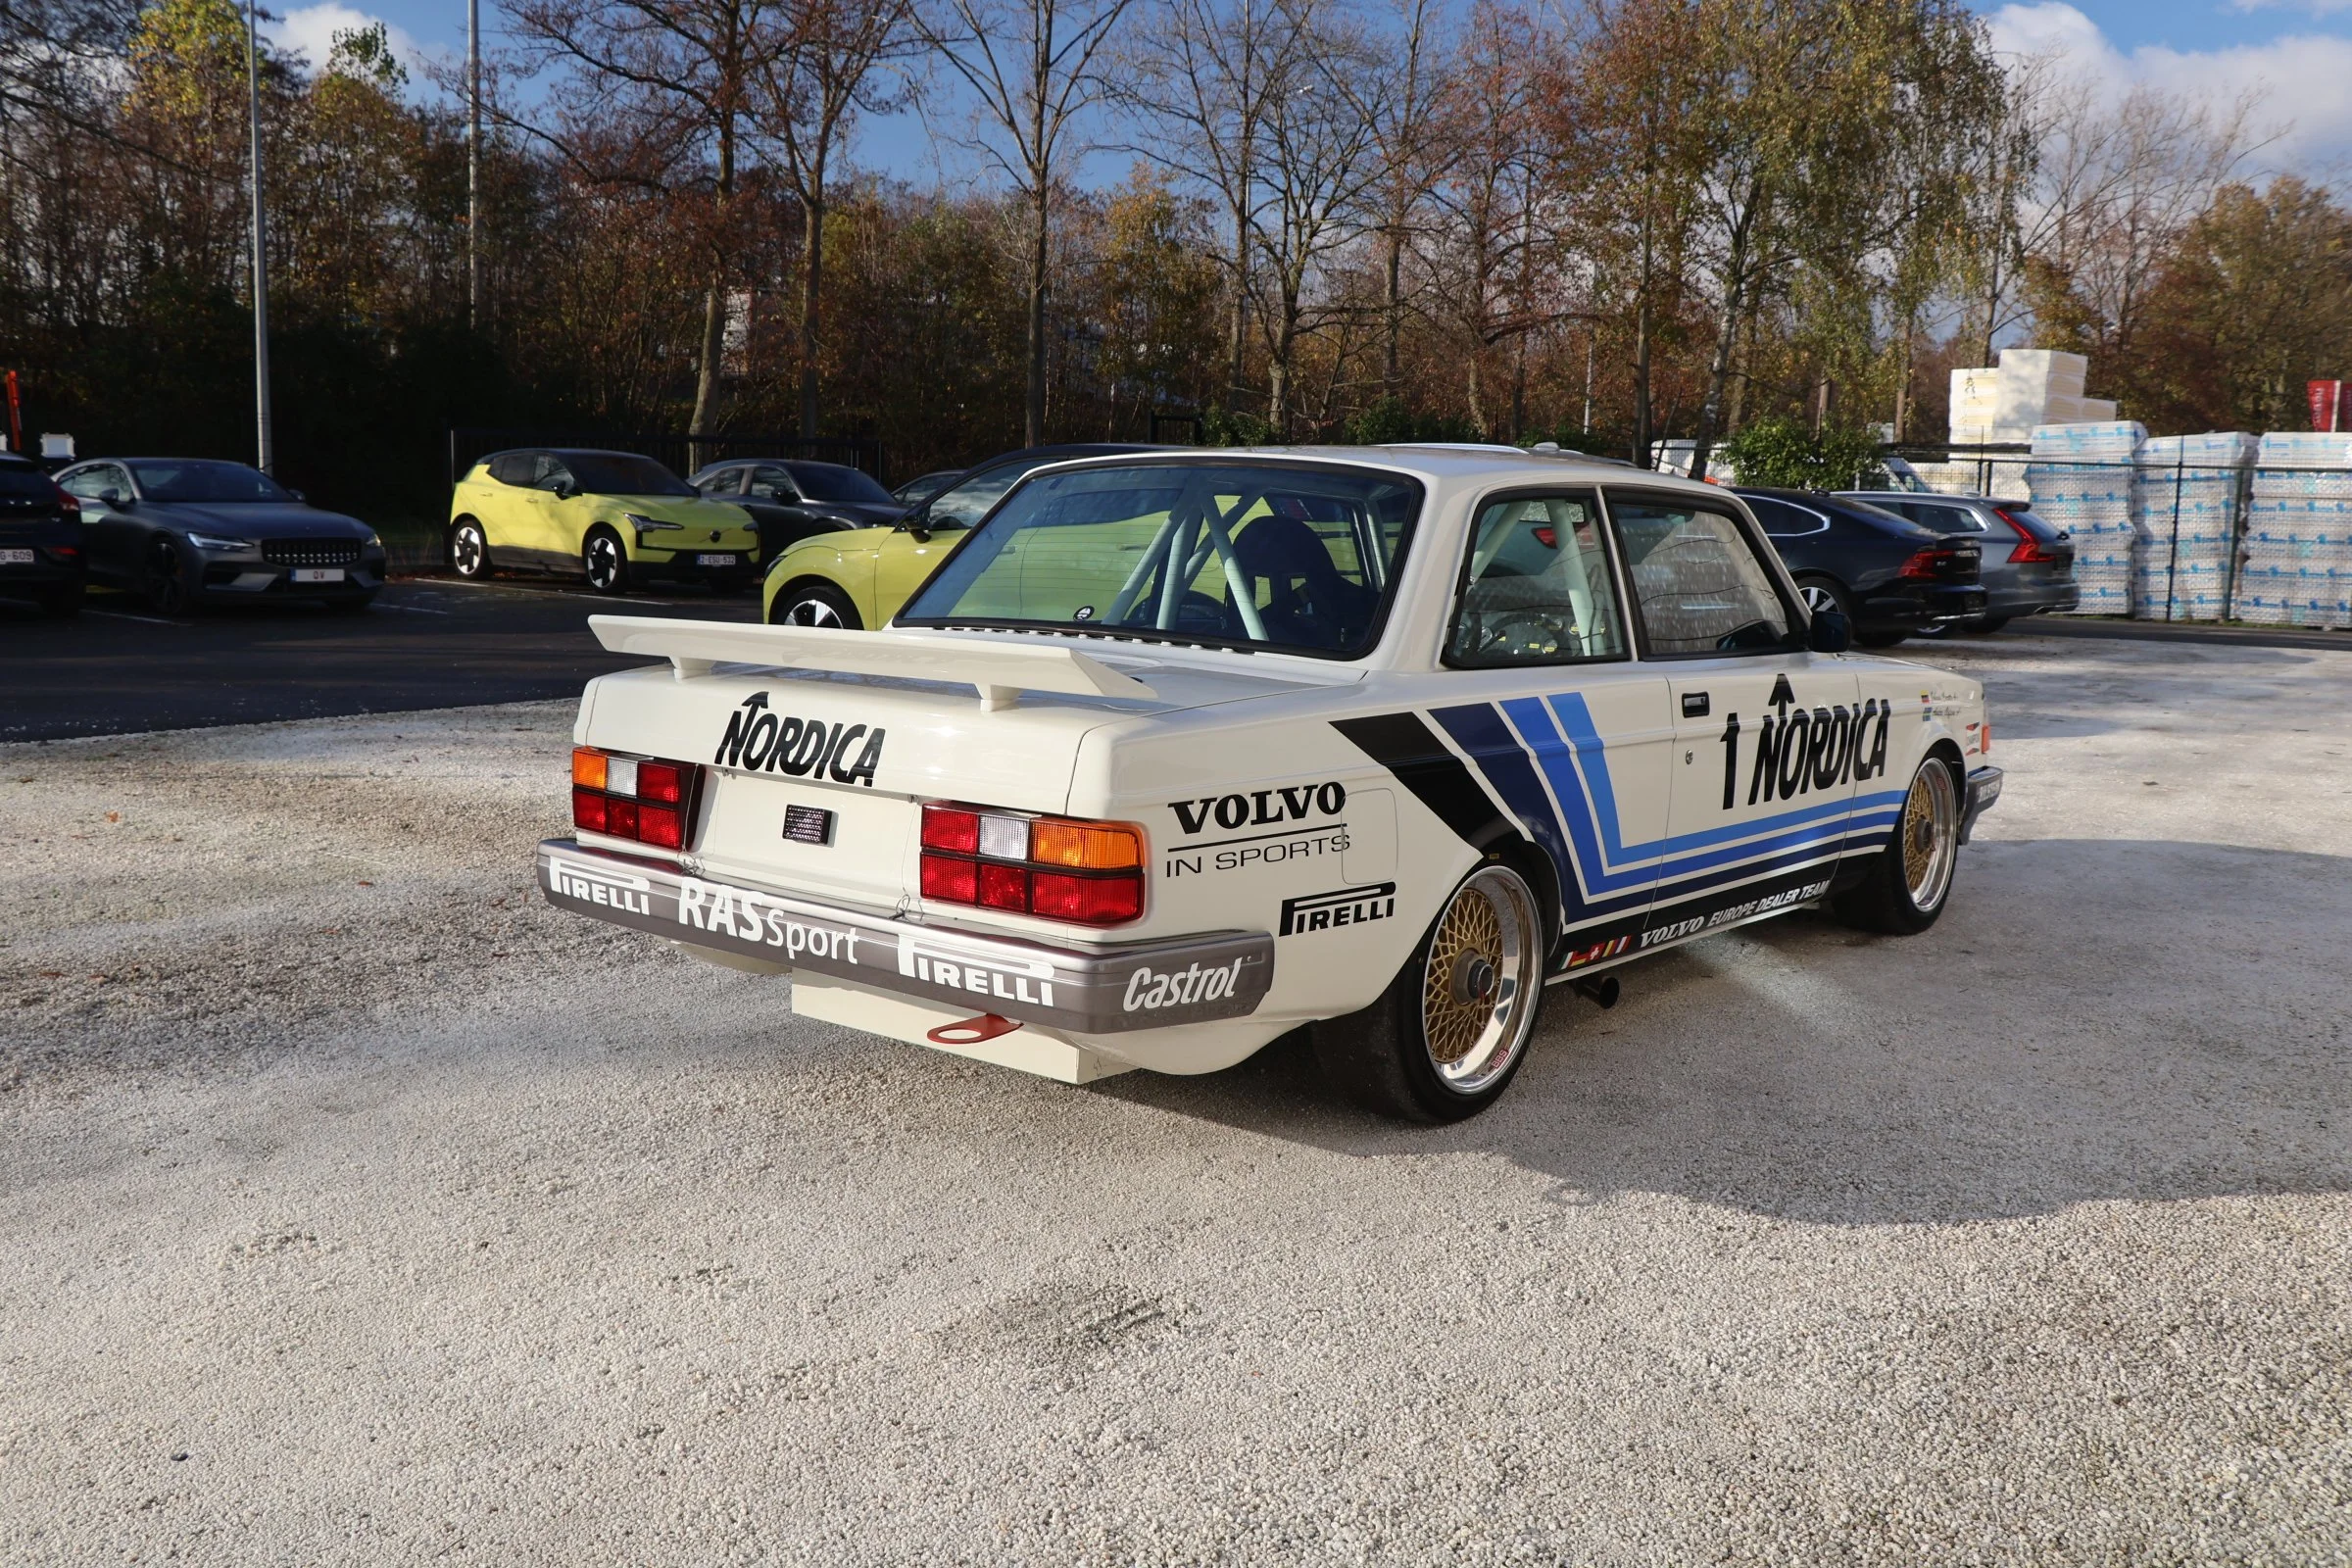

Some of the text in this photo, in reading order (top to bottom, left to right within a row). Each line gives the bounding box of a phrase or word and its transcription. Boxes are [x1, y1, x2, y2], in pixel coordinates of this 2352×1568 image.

[714, 691, 886, 787] NORDICA
[1720, 673, 1891, 810] 1 NORDICA
[1167, 781, 1346, 835] VOLVO
[1166, 834, 1350, 878] IN SPORTS
[549, 856, 651, 916] PIRELLI
[1278, 881, 1396, 937] PIRELLI
[1641, 880, 1831, 948] VOLVO EUROPE DEALER TEAM
[898, 933, 1055, 1007] PIRELLI
[1123, 956, 1243, 1012] Castrol
[1491, 1049, 1508, 1068] BBS
